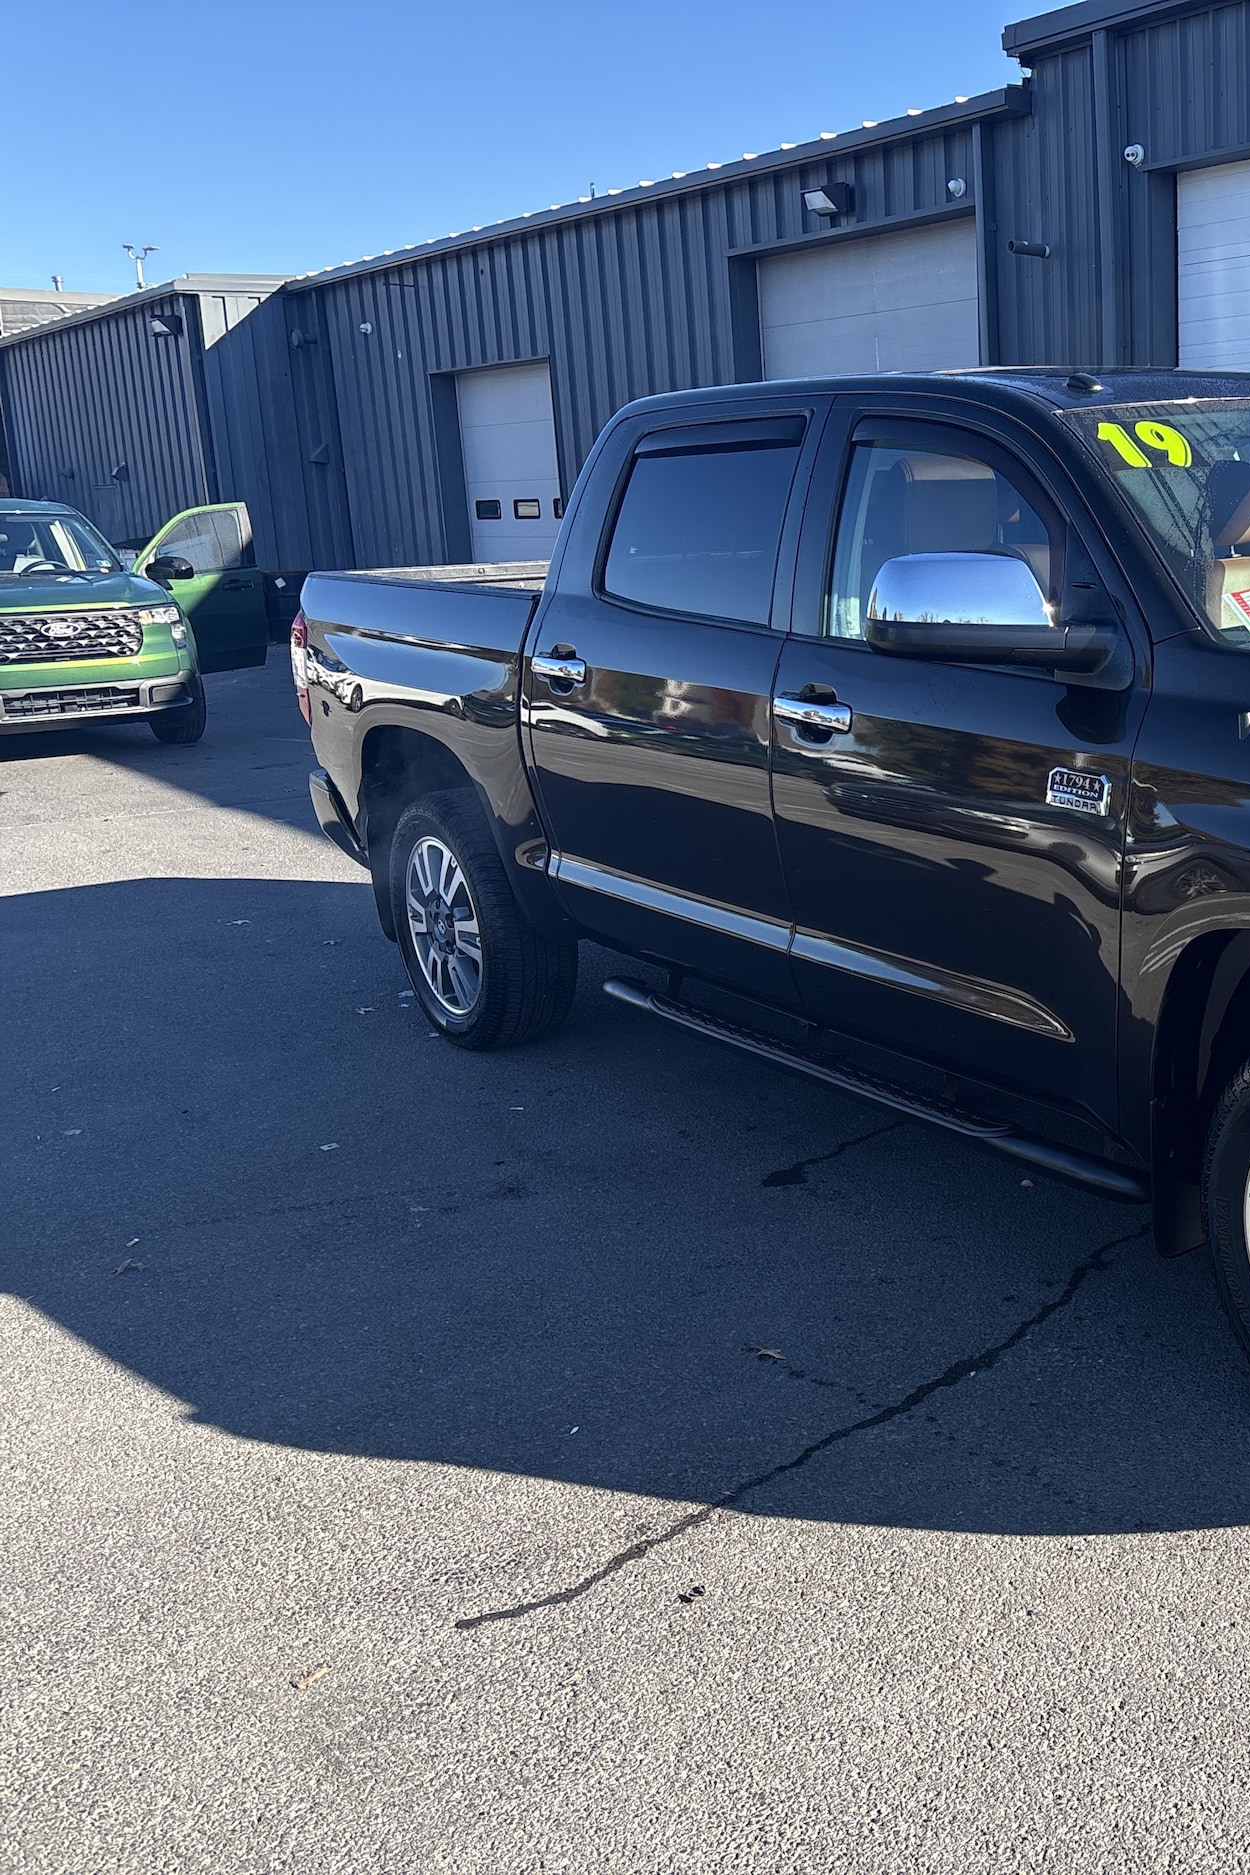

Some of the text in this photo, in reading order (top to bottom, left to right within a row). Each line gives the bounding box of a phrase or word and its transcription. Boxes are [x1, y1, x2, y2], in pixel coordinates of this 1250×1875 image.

[1097, 420, 1192, 468] 19
[1062, 773, 1091, 790] 1794
[1053, 784, 1099, 798] EDITION
[1053, 796, 1097, 811] TUNDRA
